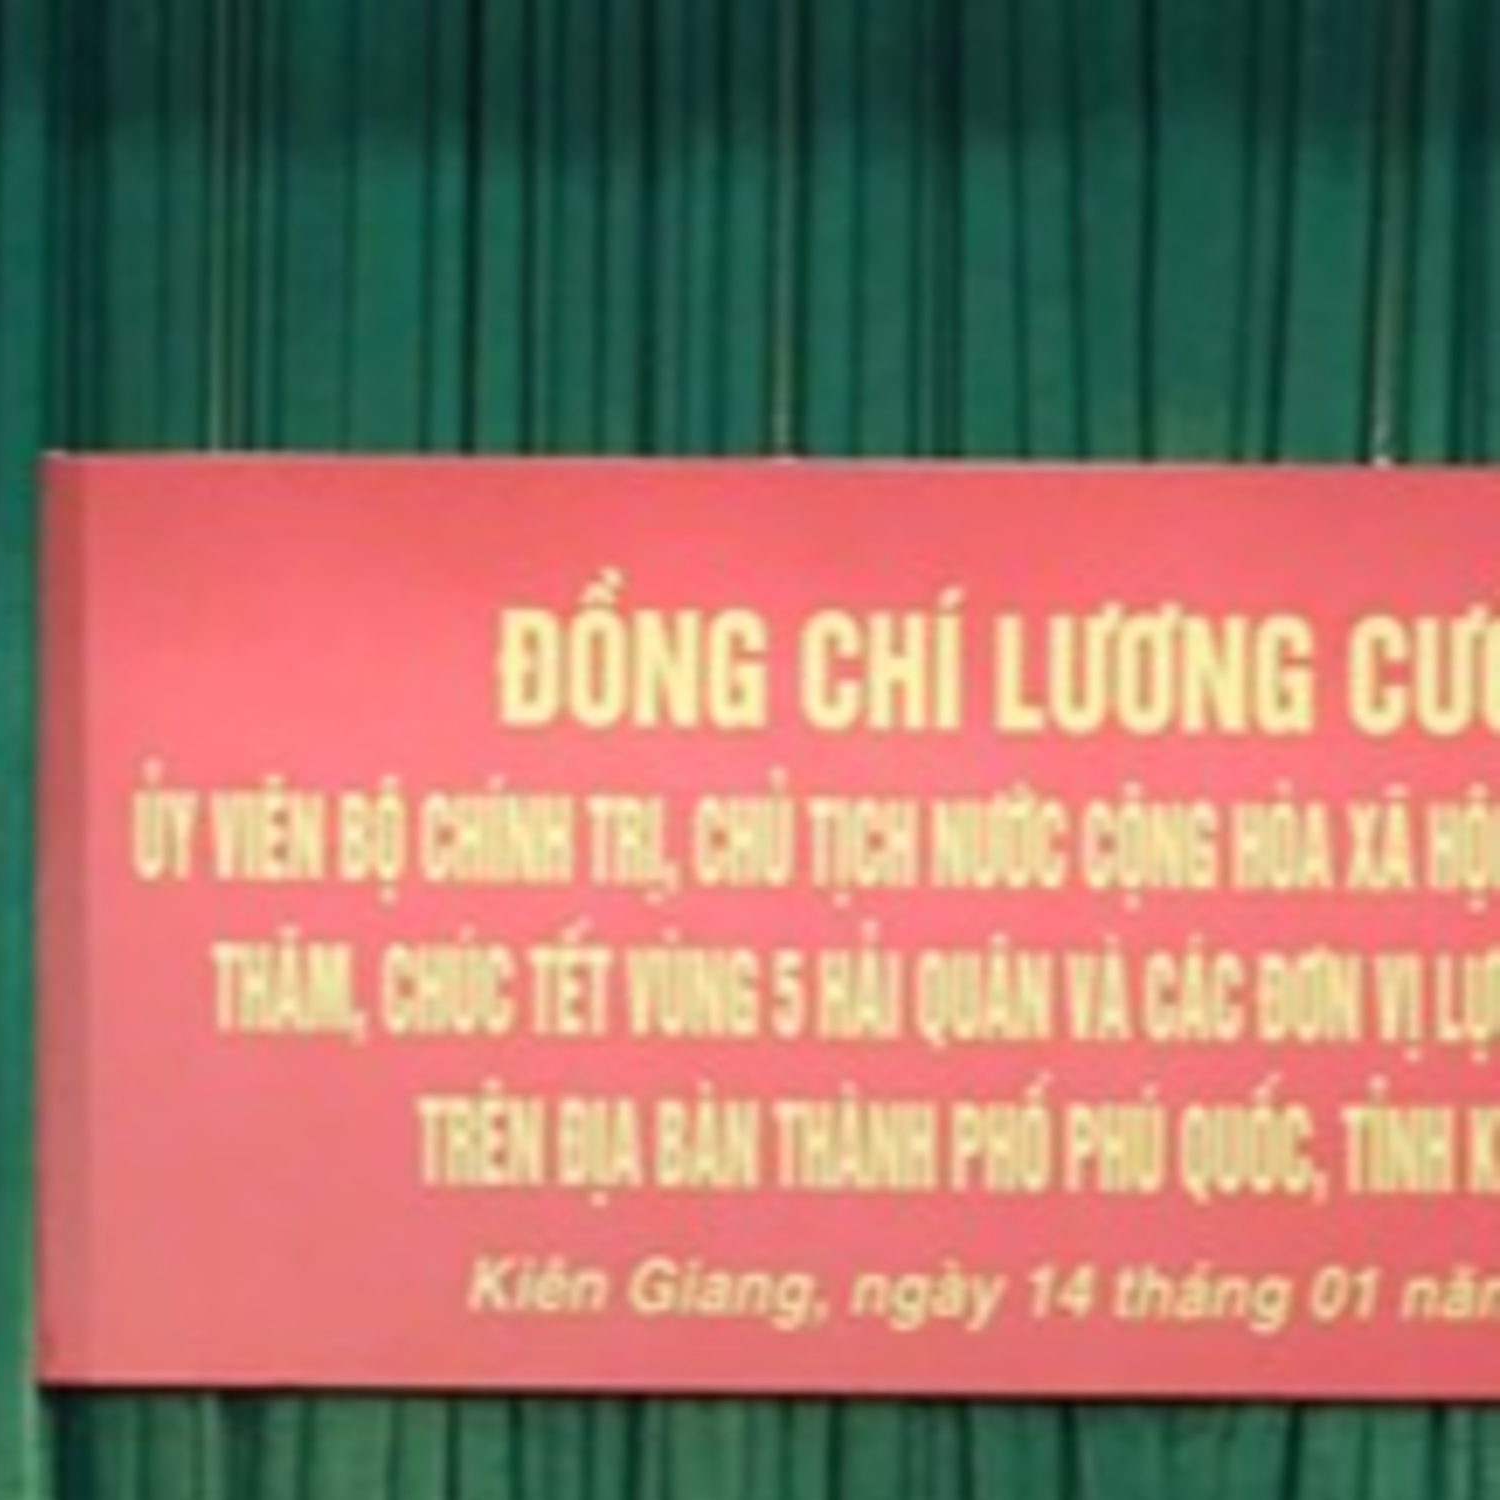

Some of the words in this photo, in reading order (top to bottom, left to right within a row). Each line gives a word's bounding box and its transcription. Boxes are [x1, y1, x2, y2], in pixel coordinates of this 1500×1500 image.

[496, 566, 769, 731] ĐỒNG
[799, 586, 963, 732] CHÍ
[994, 600, 1315, 735] LƯƠNG
[132, 758, 200, 881] ỦY
[210, 773, 326, 882] VIÊN
[337, 774, 407, 905] BỘ
[419, 774, 577, 885] CHÍNH
[585, 793, 682, 905] TRỊ,
[692, 765, 797, 888] CHỦ
[806, 796, 920, 907] TỊCH
[930, 781, 1070, 890] NƯỚC
[1080, 781, 1219, 911] CỘNG
[1231, 780, 1334, 891] HÒA
[1347, 783, 1415, 891] XÃ
[381, 925, 517, 1036] CHÚC
[526, 917, 615, 1037] TẾT
[625, 926, 761, 1038] VÙNG
[771, 947, 806, 1039] 5
[817, 919, 903, 1040] HẢI
[915, 932, 1054, 1048] QUÂN
[1065, 934, 1132, 1041] VÀ
[1143, 934, 1244, 1042] CÁC
[1256, 944, 1362, 1043] ĐƠN
[1375, 953, 1422, 1063] VỊ
[417, 1077, 545, 1186] TRÊN
[557, 1096, 644, 1207] ĐỊA
[655, 1079, 760, 1188] BÀN
[773, 1080, 937, 1190] THÀNH
[950, 1072, 1052, 1192] PHỐ
[1064, 1084, 1167, 1192] PHÚ
[1180, 1073, 1328, 1205] QUỐC,
[1341, 1074, 1454, 1193] TỈNH
[468, 1256, 609, 1312] Kiên
[628, 1255, 829, 1331] Giang,
[852, 1260, 1006, 1331] ngày
[1029, 1265, 1096, 1318] 14
[1114, 1261, 1293, 1334] tháng
[1311, 1264, 1380, 1321] 01
